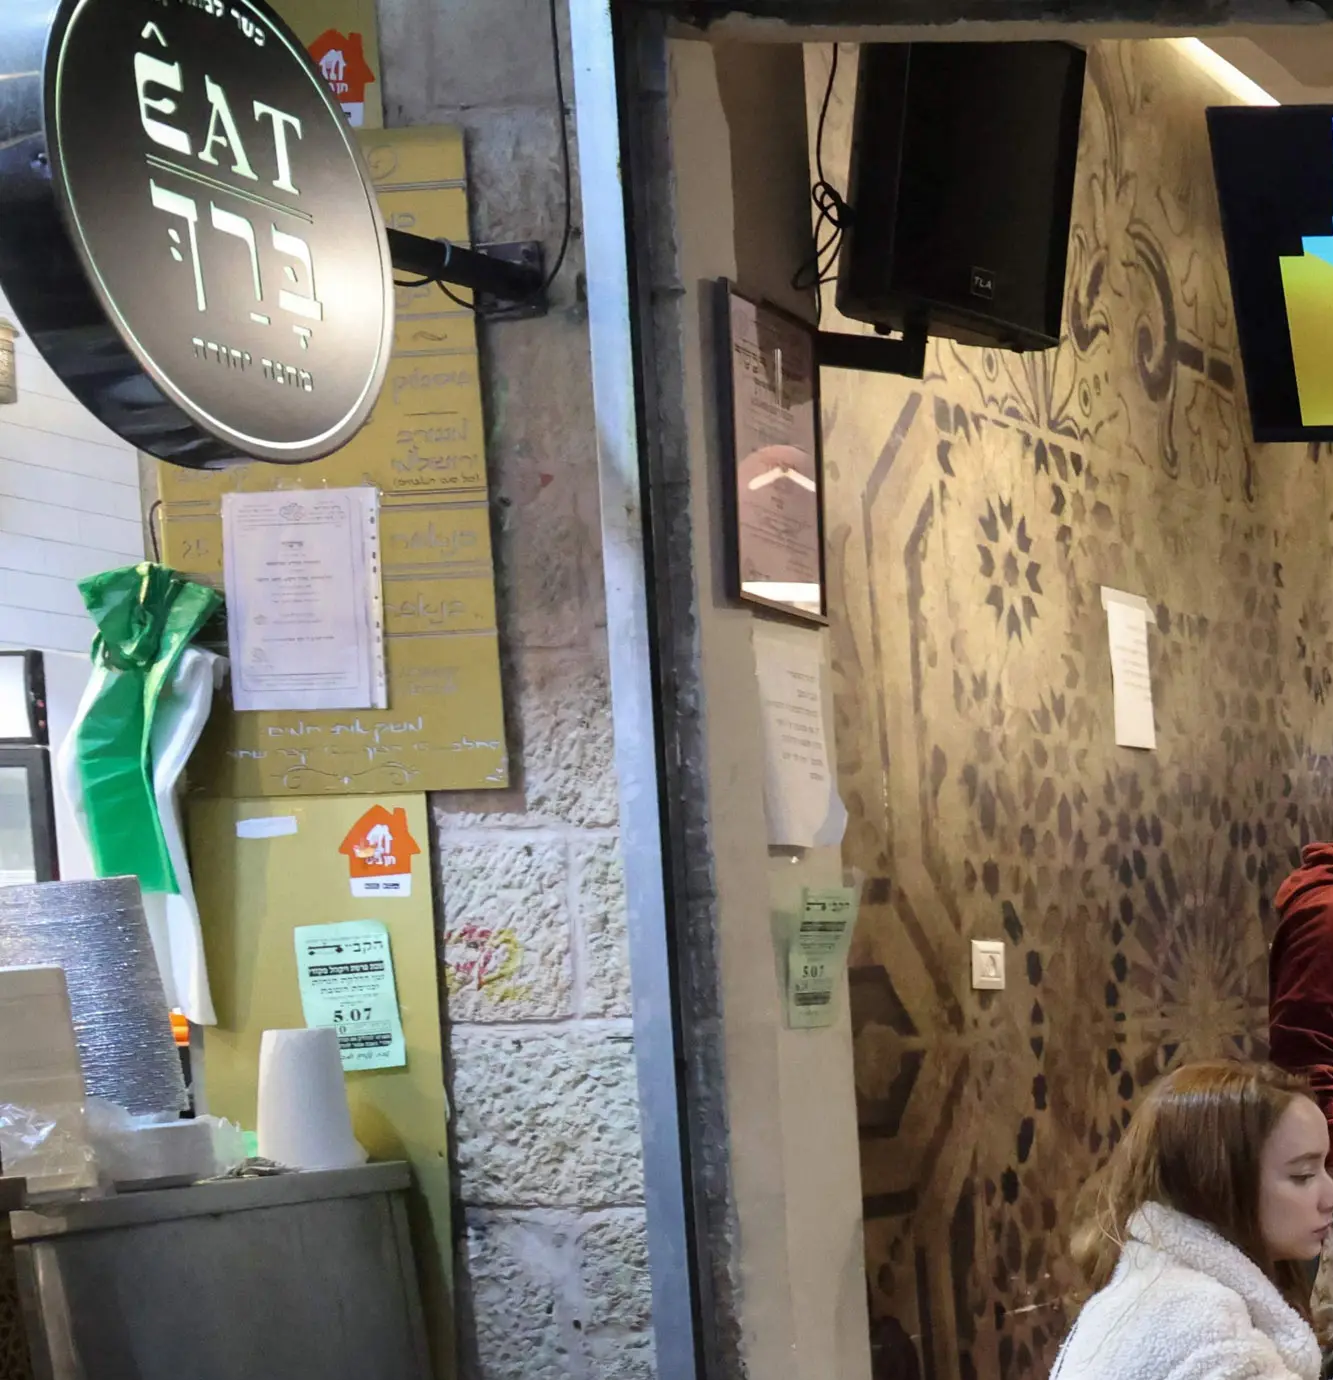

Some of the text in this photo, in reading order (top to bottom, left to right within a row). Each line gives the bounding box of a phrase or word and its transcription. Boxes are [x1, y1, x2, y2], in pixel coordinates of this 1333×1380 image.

[192, 337, 313, 391] מחנה יהודה
[333, 1008, 372, 1023] 5.07
